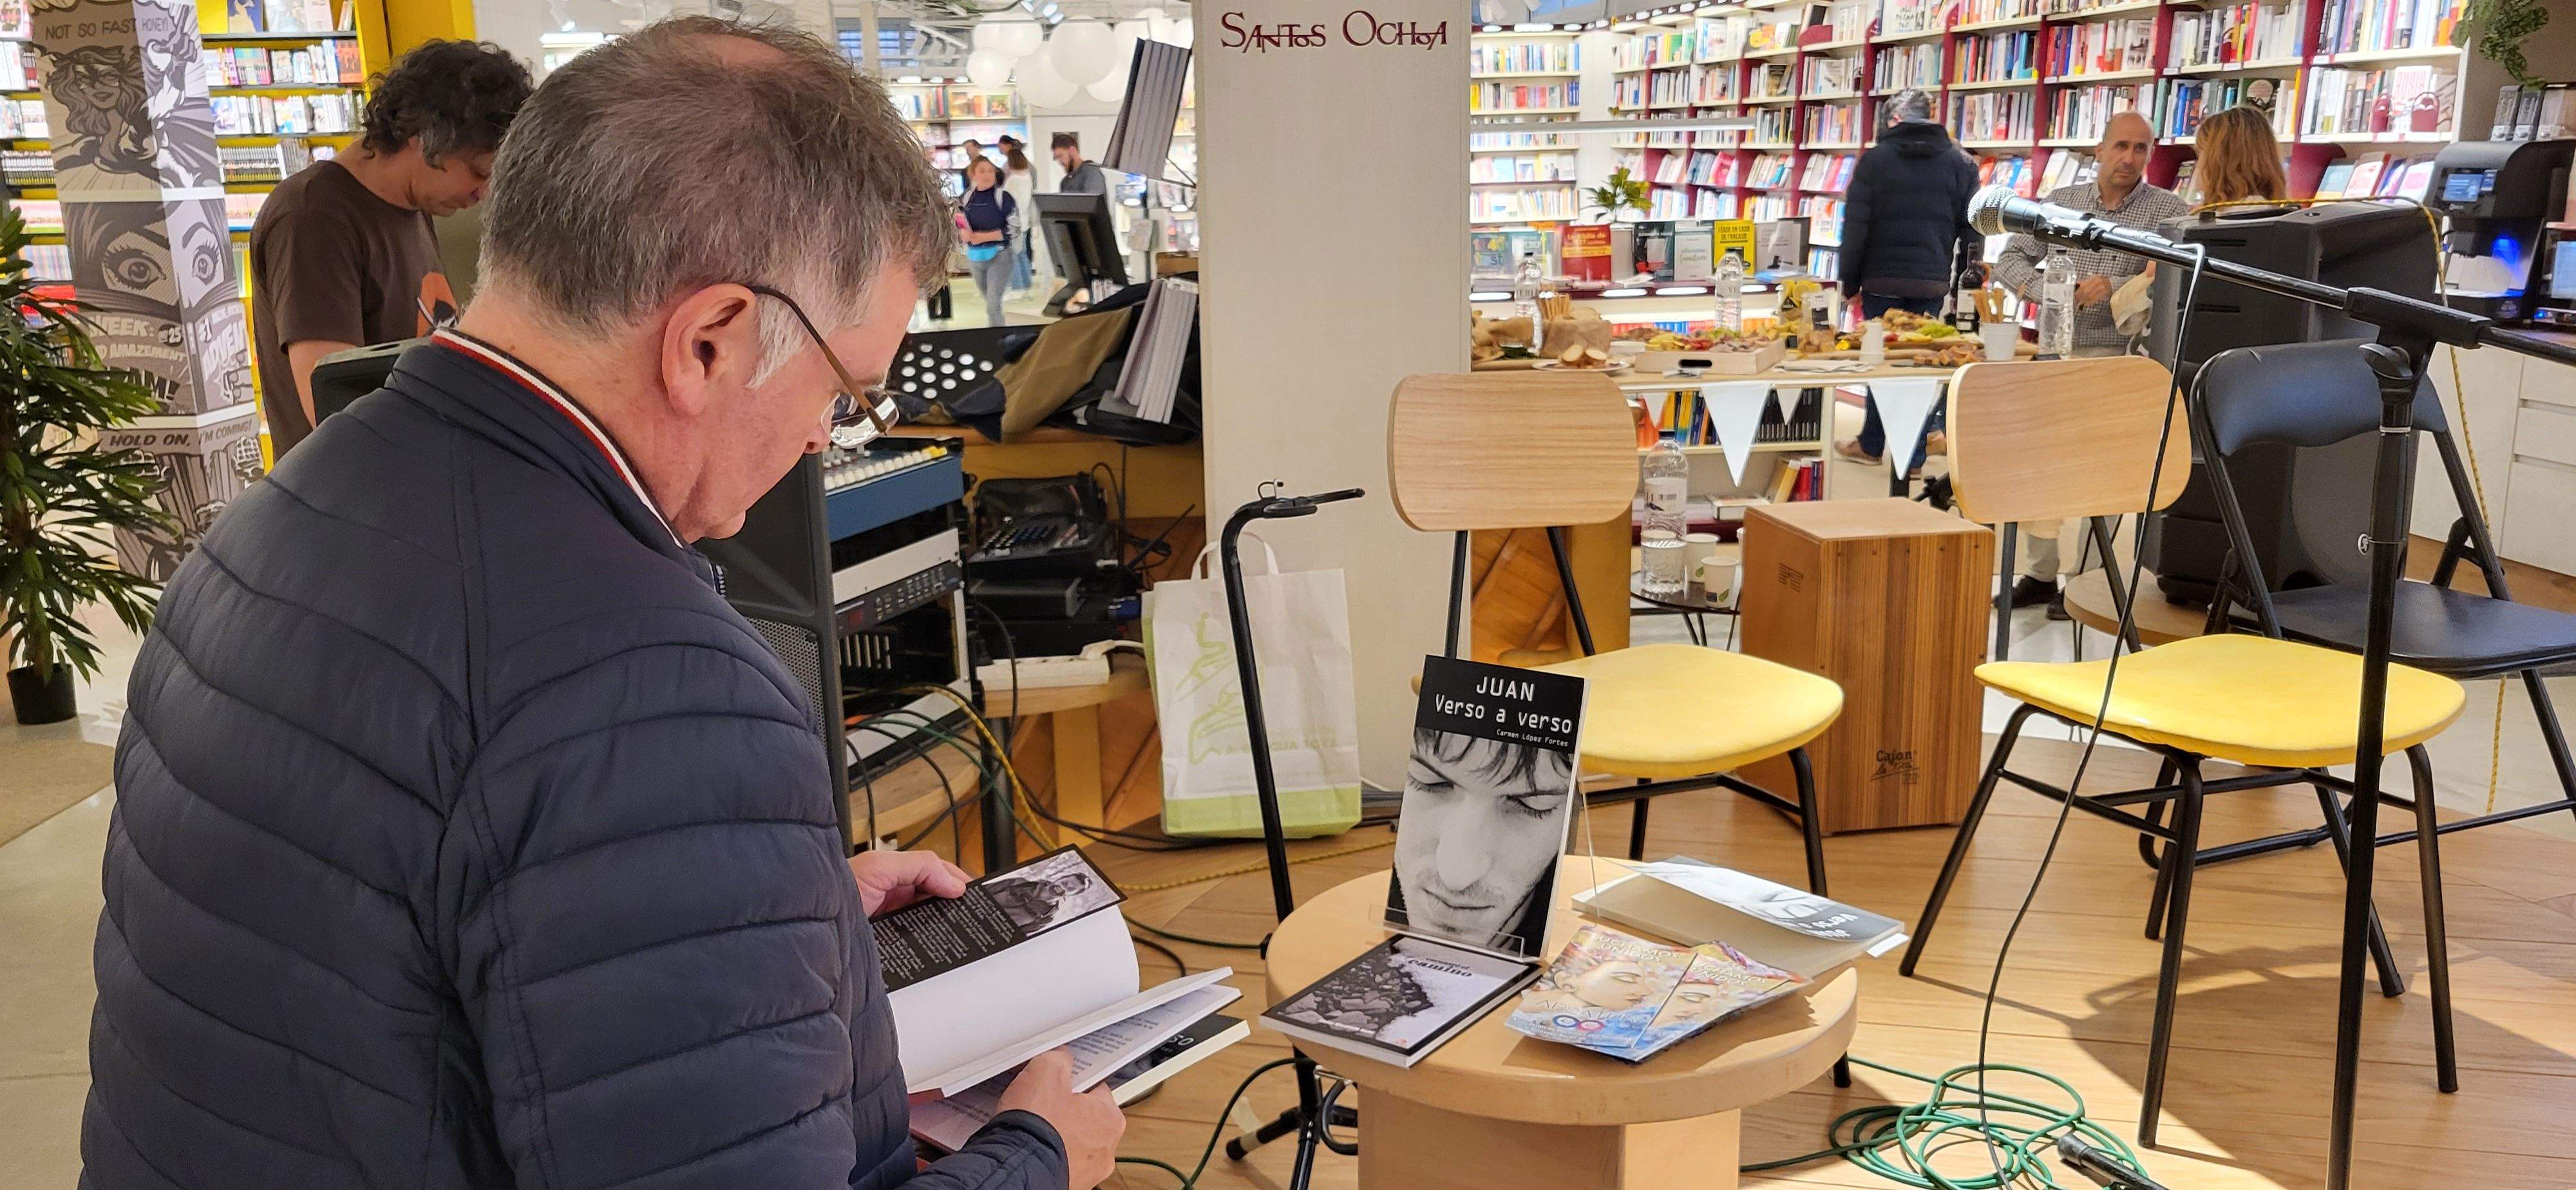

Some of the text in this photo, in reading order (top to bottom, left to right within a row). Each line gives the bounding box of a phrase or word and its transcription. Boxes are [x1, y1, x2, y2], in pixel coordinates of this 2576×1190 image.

[45, 24, 71, 40] NOT
[78, 23, 97, 38] SO
[102, 19, 137, 35] FAST
[109, 434, 156, 446] HOLD
[163, 434, 191, 446] ON,
[216, 419, 252, 440] COMING!
[1476, 676, 1535, 702] JUAN
[1435, 694, 1573, 734] Verso a verso
[1497, 729, 1569, 747] Carmen López Fortes
[1591, 931, 1679, 959] LUCHAMOS
[1601, 942, 1661, 962] UNIDOS
[1408, 959, 1472, 977] camino
